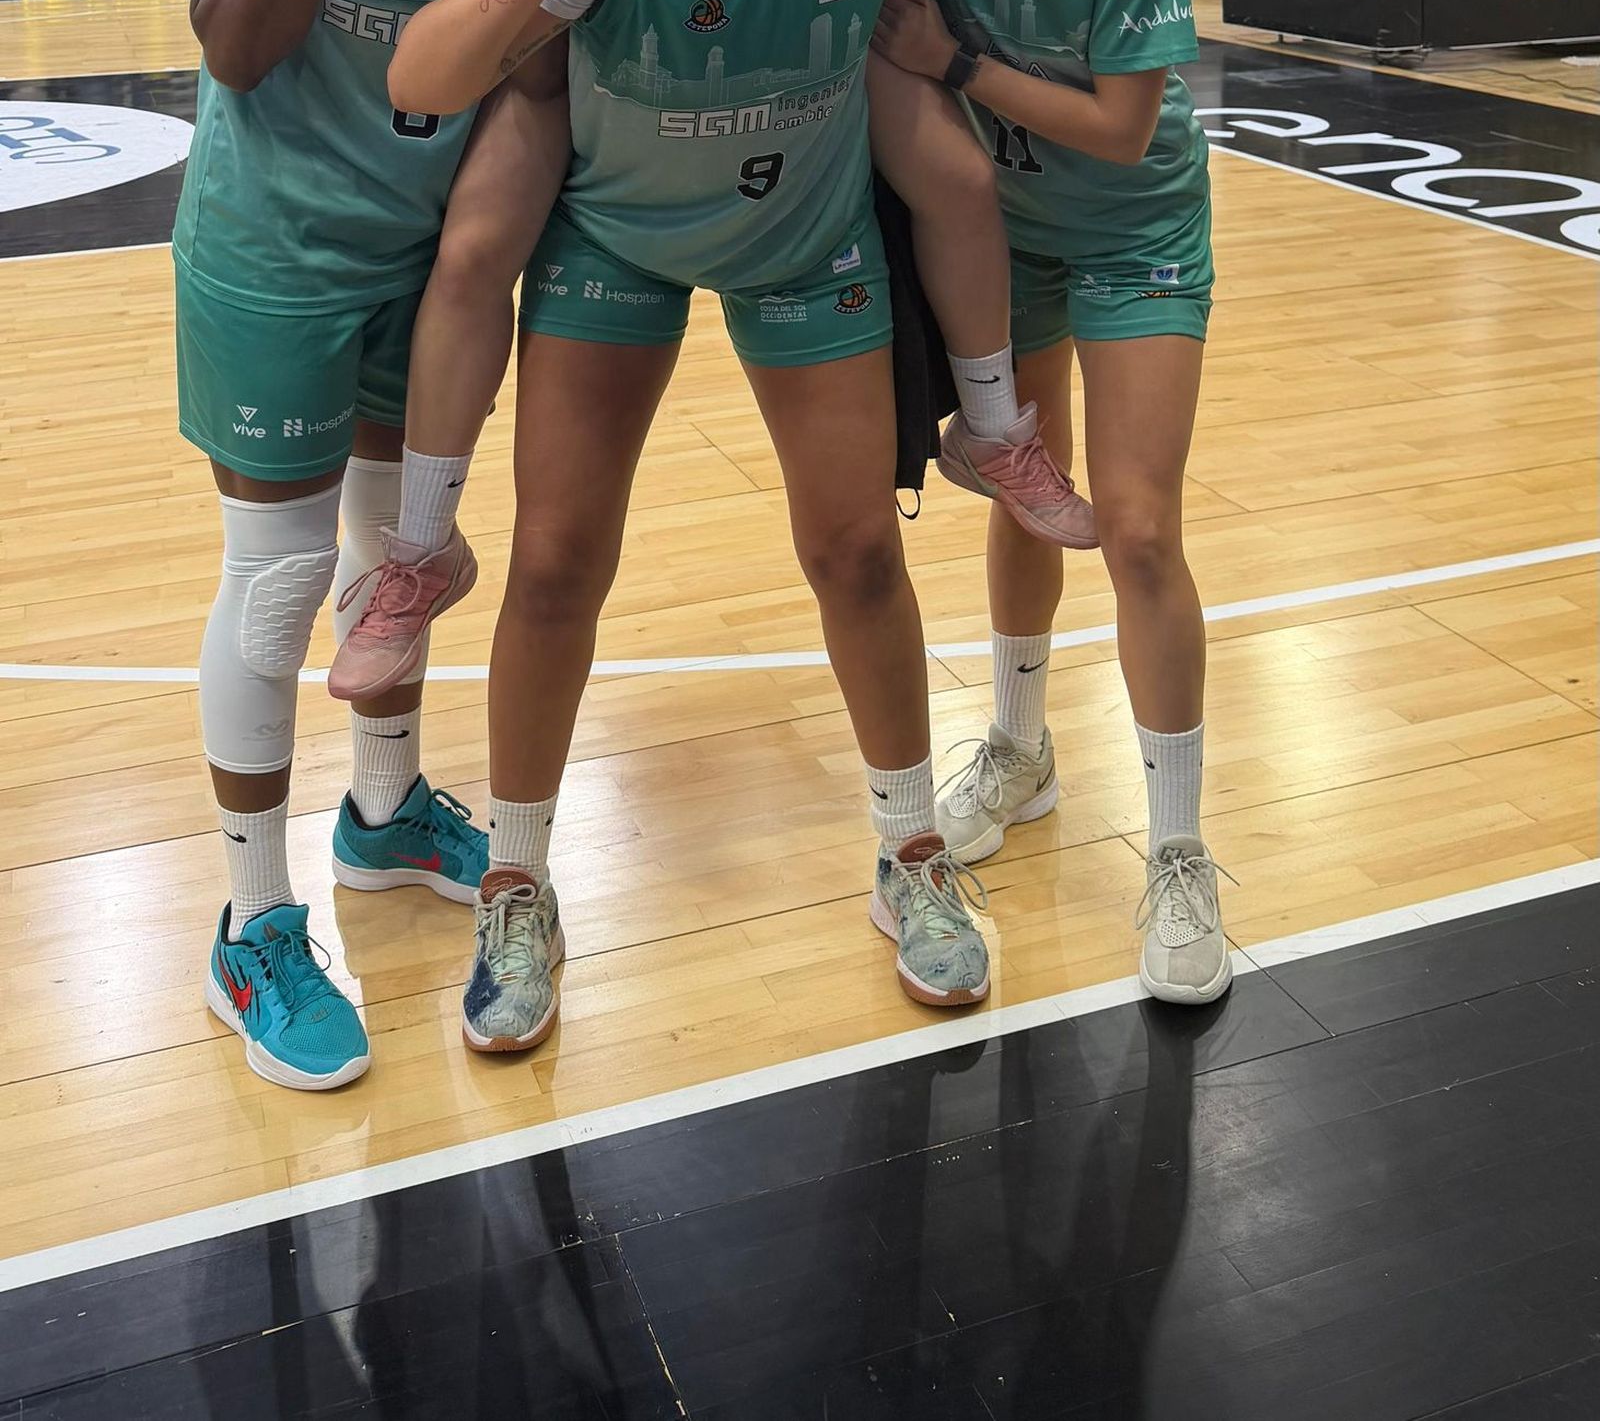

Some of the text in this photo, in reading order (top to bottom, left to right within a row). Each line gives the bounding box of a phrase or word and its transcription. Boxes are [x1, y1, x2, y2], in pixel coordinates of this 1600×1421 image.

[658, 102, 772, 139] SGM
[773, 105, 834, 131] ambie
[736, 150, 786, 202] 9
[537, 280, 569, 296] vive
[606, 289, 666, 306] Hospiten
[233, 422, 267, 439] vive
